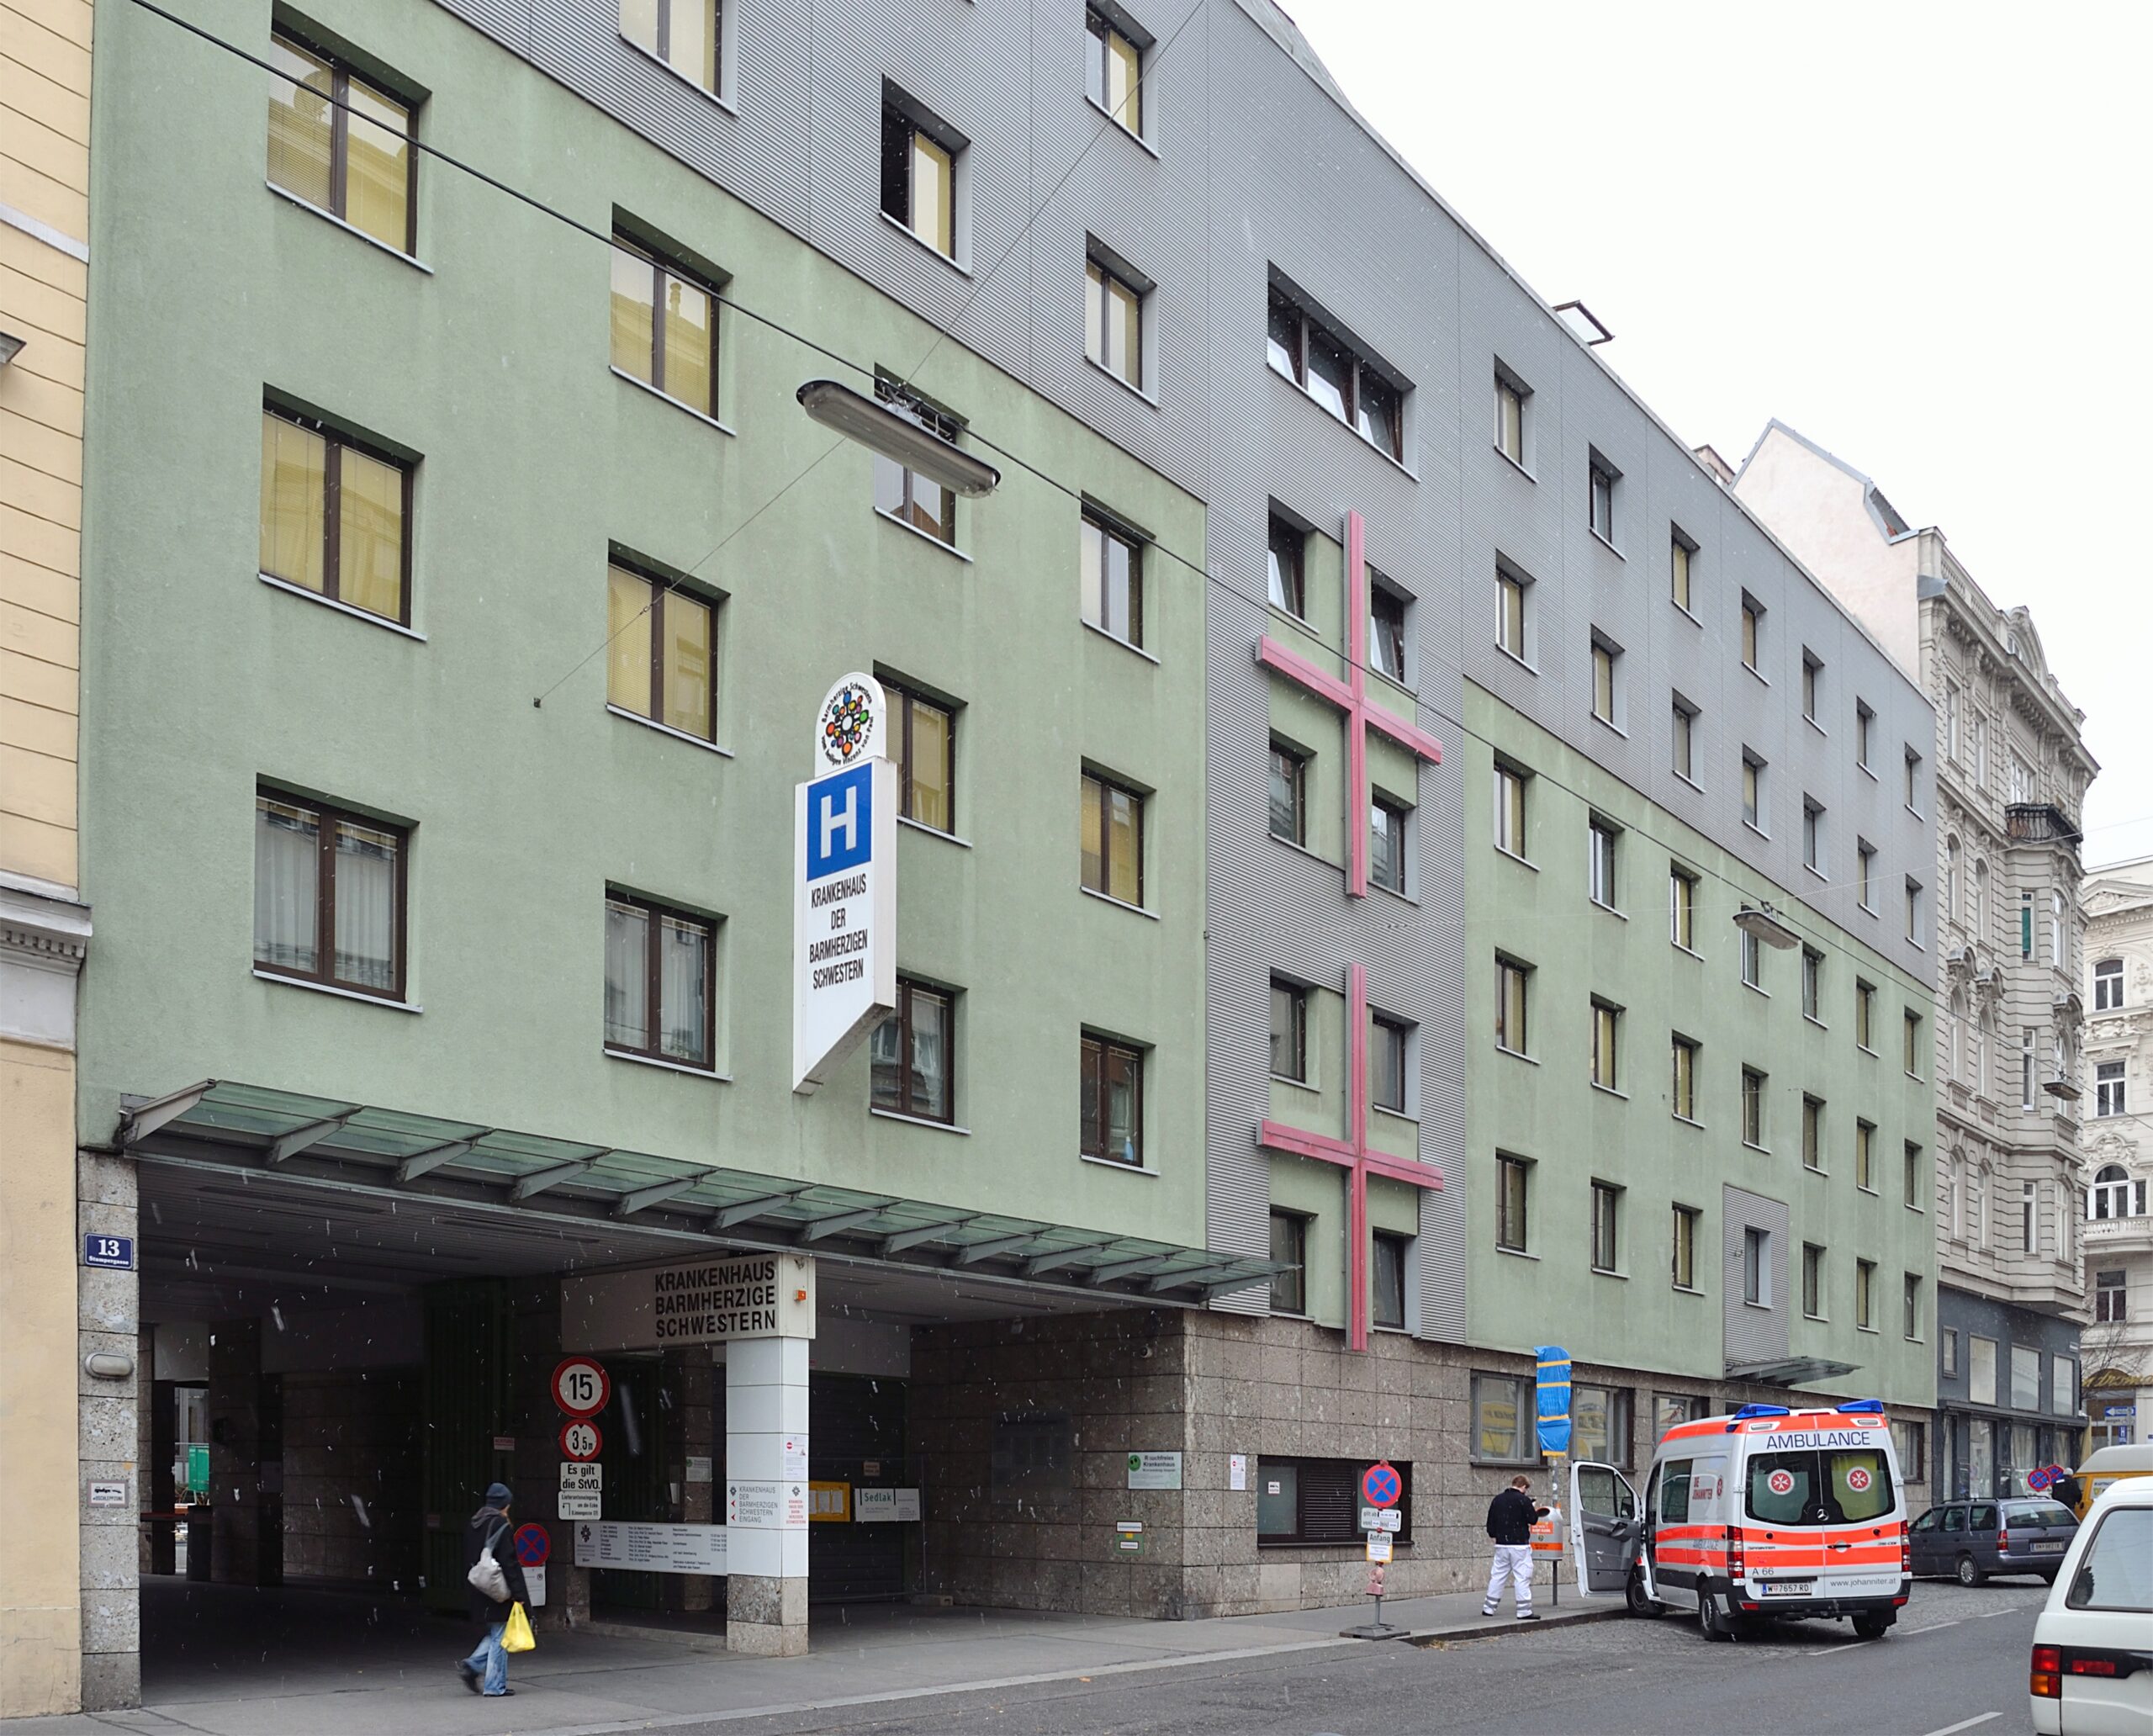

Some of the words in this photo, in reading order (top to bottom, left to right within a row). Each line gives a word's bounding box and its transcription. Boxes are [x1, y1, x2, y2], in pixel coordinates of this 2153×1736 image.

[821, 786, 857, 860] H
[811, 873, 866, 909] KRANKENHAUS
[831, 908, 846, 930] DER
[809, 929, 868, 963] BARMHERZIGEN
[813, 958, 864, 990] SCHWESTERN
[98, 1239, 119, 1257] 13
[655, 1261, 775, 1292] KRANKENHAUS
[656, 1285, 775, 1315] BARMHERZIGE
[656, 1310, 775, 1338] SCHWESTERN
[569, 1373, 593, 1400] 15
[1766, 1432, 1870, 1449] AMBULANCE
[568, 1464, 577, 1474] Es
[581, 1464, 595, 1477] gilt
[563, 1479, 575, 1489] die
[579, 1479, 600, 1490] StVO.
[865, 1492, 891, 1502] Sedlak
[1370, 1534, 1390, 1543] Anfang
[1768, 1584, 1773, 1592] W
[1779, 1583, 1797, 1592] 7657
[1830, 1578, 1896, 1588] www.johanniter.at
